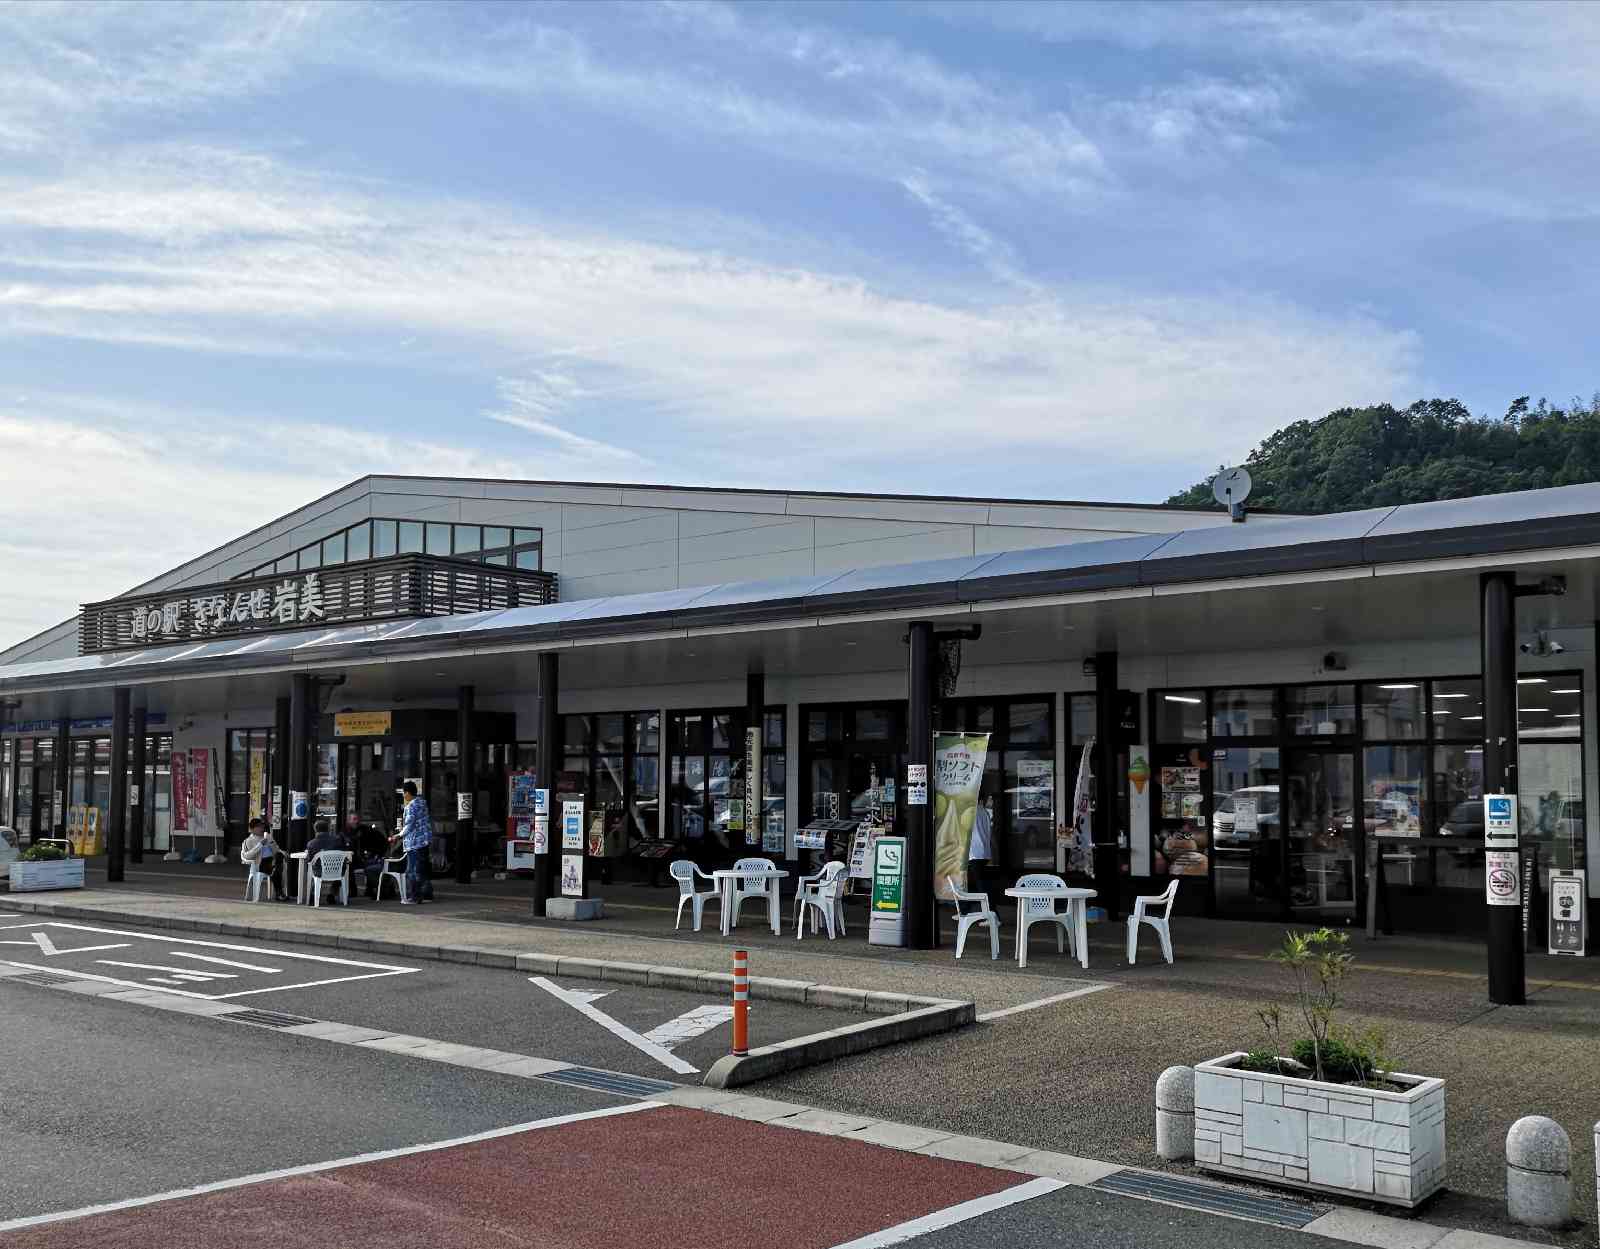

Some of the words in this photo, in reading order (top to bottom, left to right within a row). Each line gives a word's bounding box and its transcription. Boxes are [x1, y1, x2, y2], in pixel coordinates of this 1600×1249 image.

[131, 601, 182, 639] 道の駅
[190, 589, 270, 632] きなんせ
[271, 573, 324, 623] 岩美
[936, 759, 980, 773] 梨ソフト
[943, 772, 971, 782] クリーム
